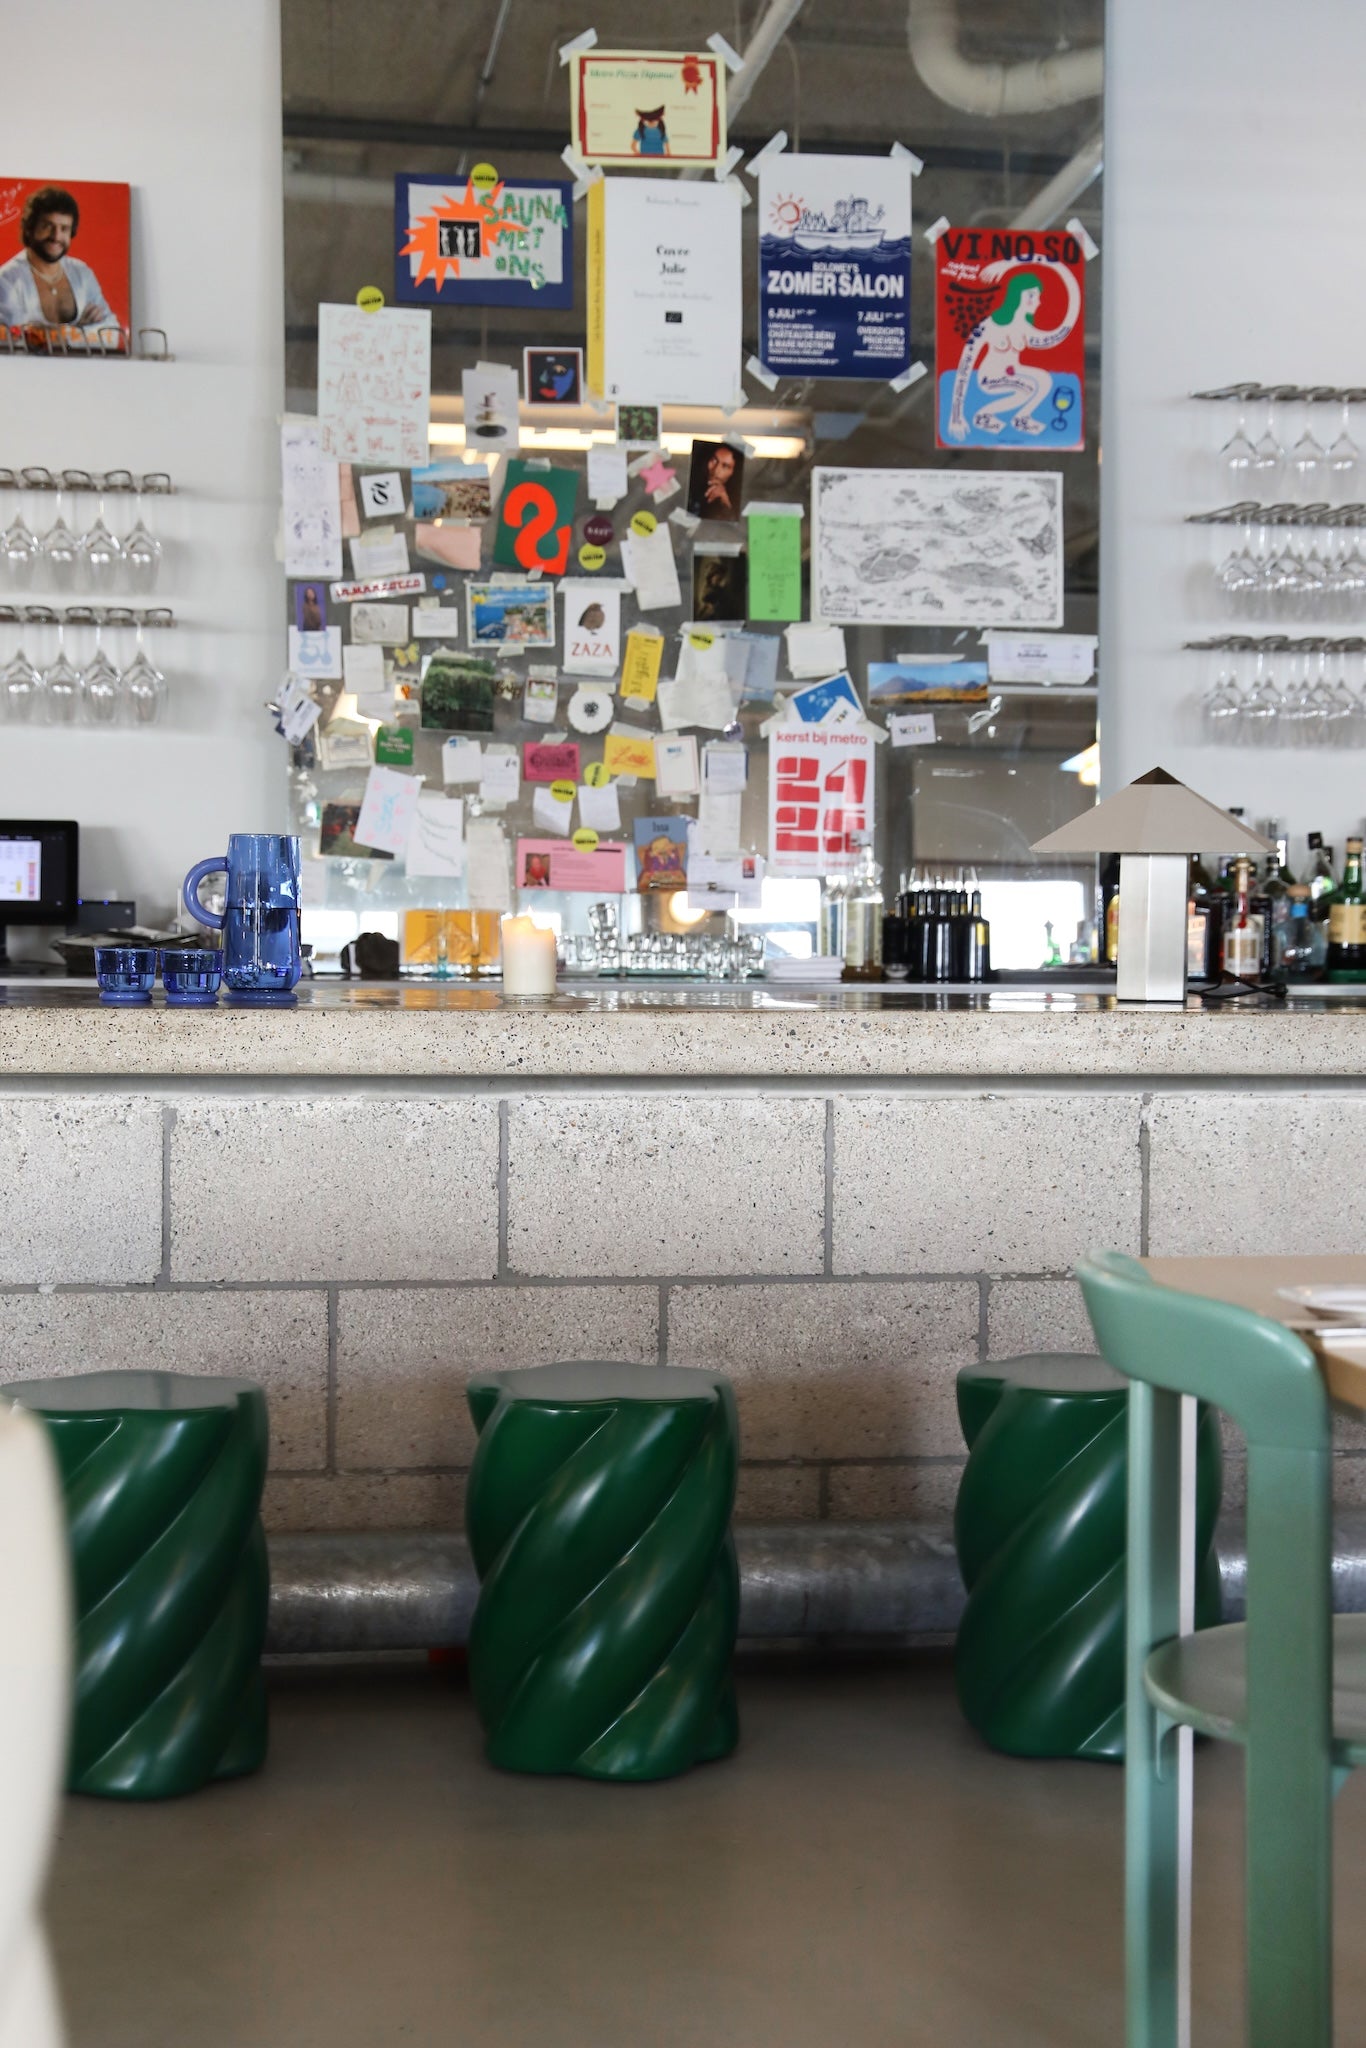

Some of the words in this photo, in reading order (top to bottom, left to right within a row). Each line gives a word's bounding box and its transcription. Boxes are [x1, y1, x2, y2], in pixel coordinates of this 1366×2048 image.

[480, 193, 567, 229] SAUNA
[497, 228, 543, 251] MET
[495, 255, 546, 290] ONS
[571, 642, 613, 657] ZAZA
[776, 731, 810, 744] kerst
[813, 732, 828, 746] bij
[830, 734, 868, 746] metro
[776, 756, 868, 804] 24
